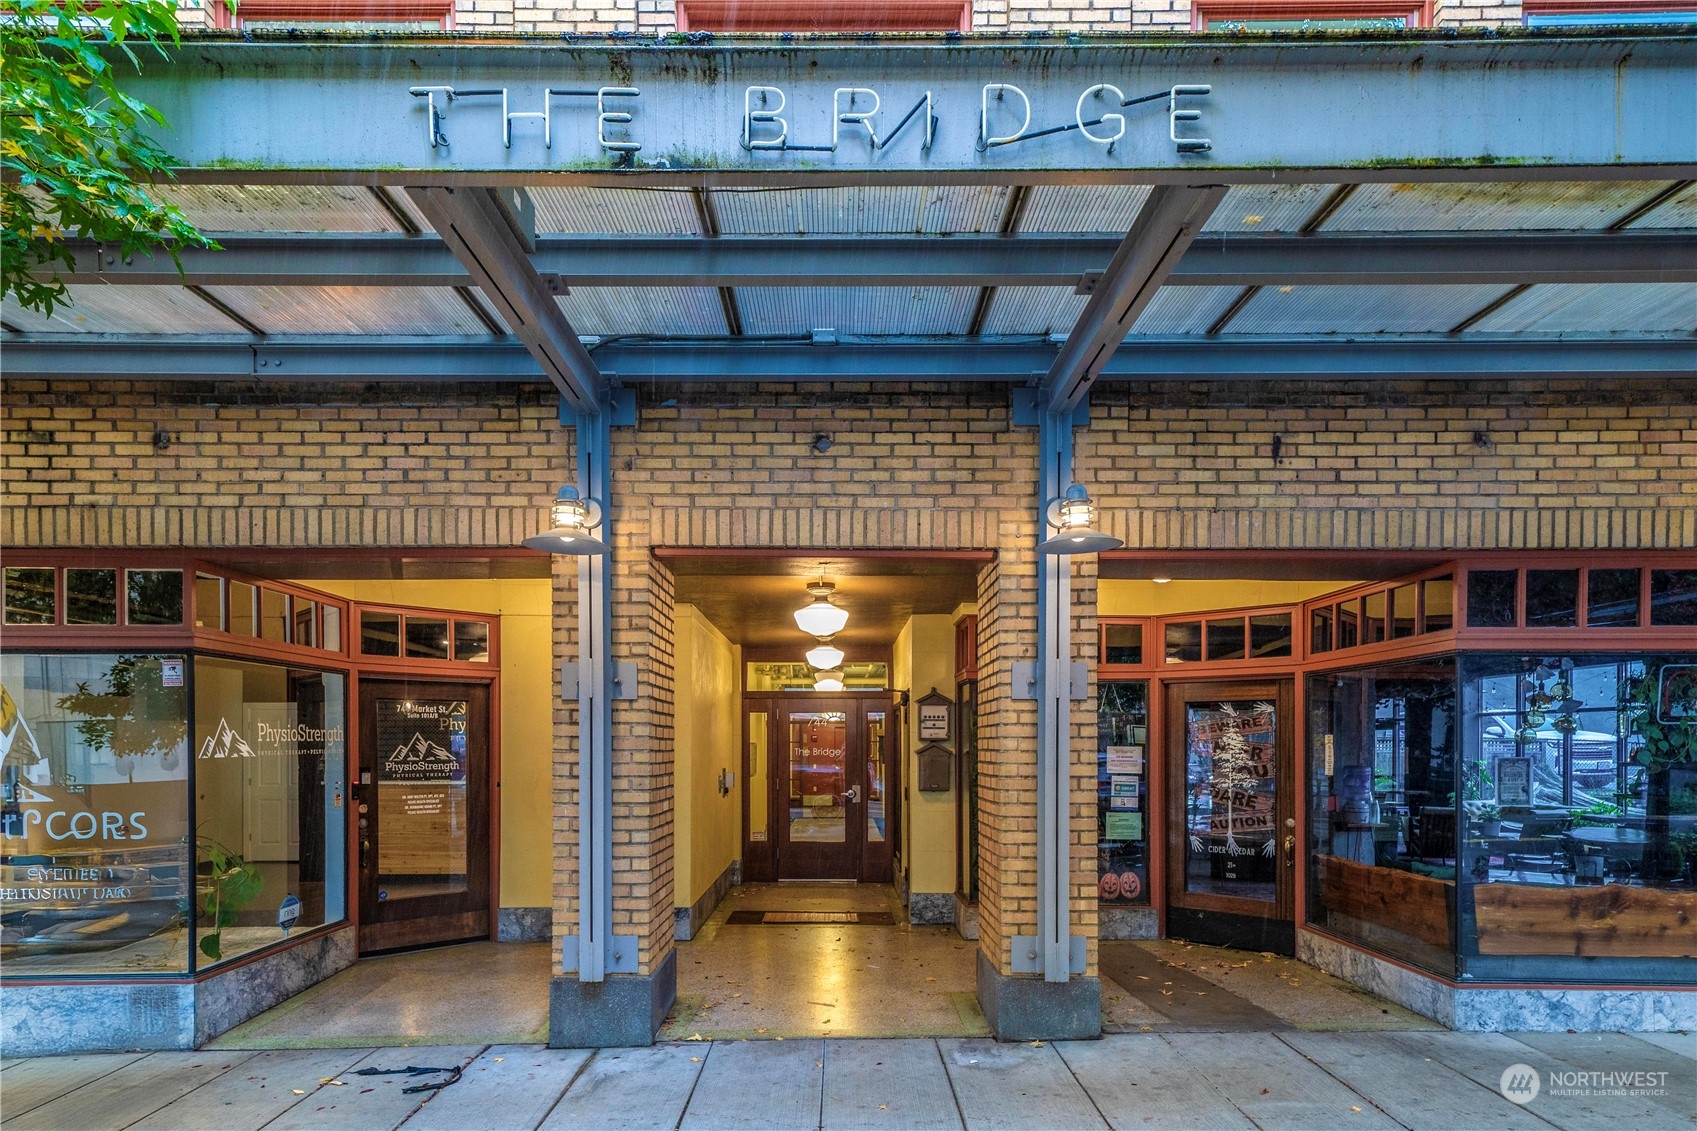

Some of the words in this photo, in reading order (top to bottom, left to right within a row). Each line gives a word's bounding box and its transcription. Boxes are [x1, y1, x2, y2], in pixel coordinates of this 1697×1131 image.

[409, 85, 641, 151] THE
[741, 82, 1213, 153] BRIDGE
[257, 722, 344, 747] PhysioStrength
[794, 747, 811, 757] The
[812, 747, 842, 758] Bridge
[385, 761, 460, 773] PhysioStrength
[1210, 815, 1268, 830] AUTION
[1207, 845, 1226, 854] CIDER
[1234, 847, 1256, 856] EDAR
